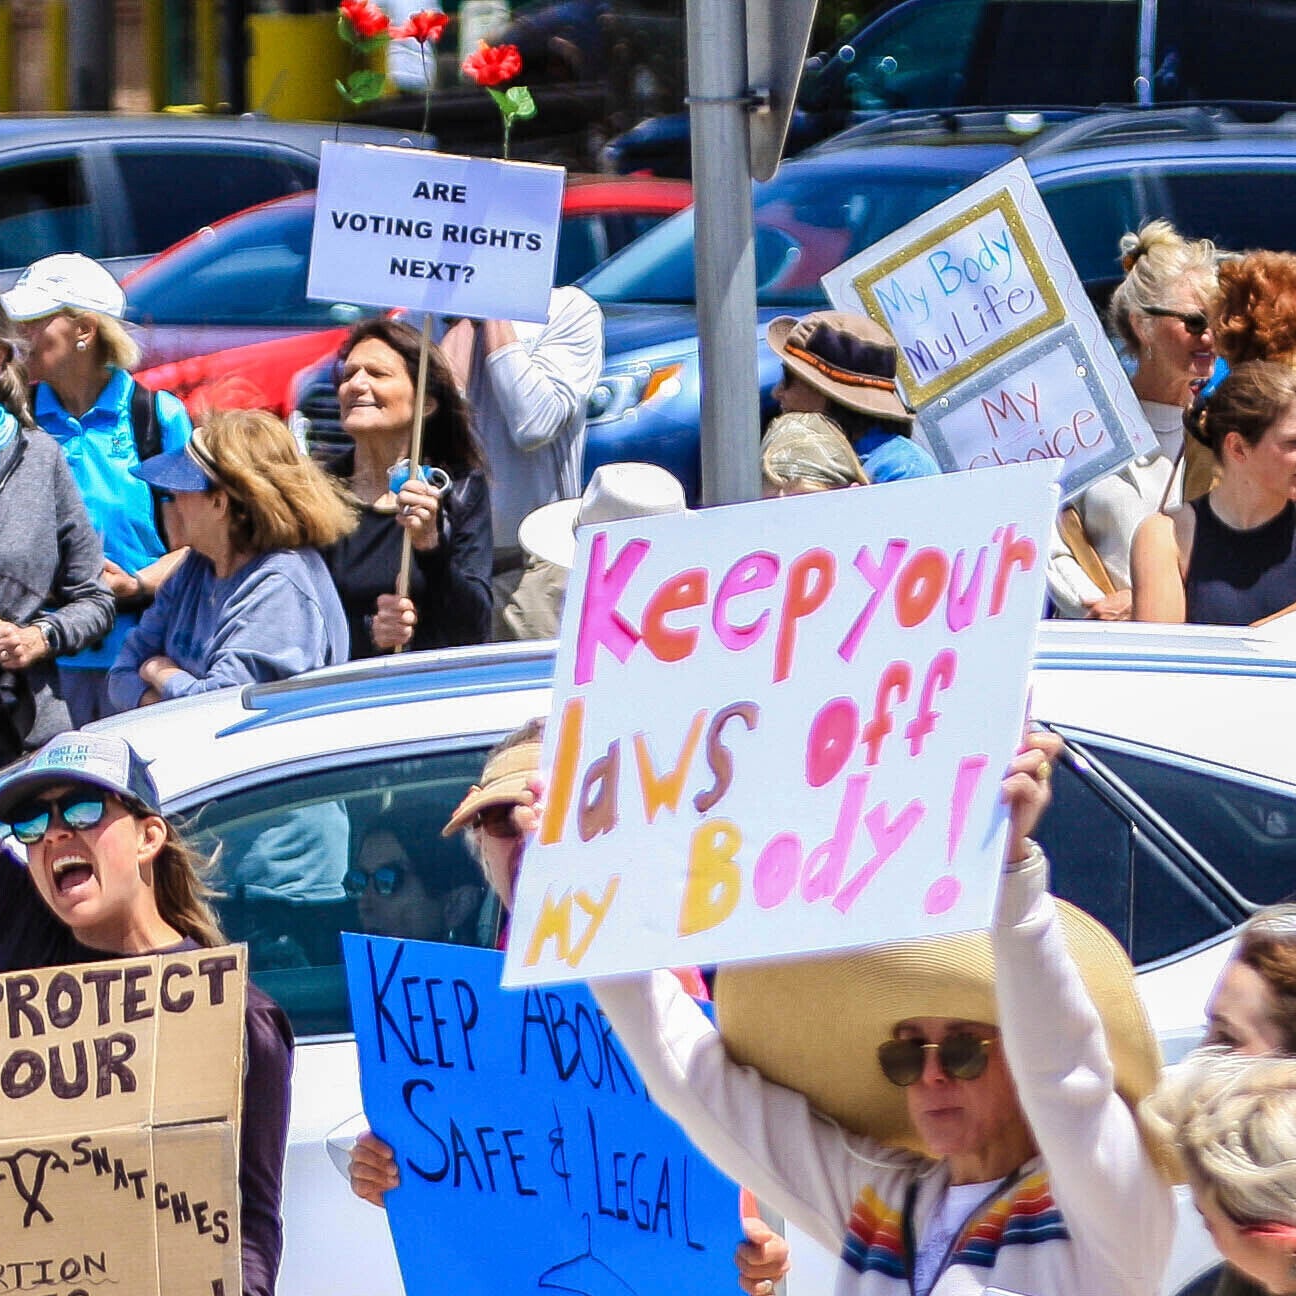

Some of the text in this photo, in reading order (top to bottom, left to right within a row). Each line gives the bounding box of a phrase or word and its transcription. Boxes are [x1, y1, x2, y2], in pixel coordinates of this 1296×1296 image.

[412, 181, 467, 204] ARE
[331, 211, 542, 253] VOTING RIGHTS
[927, 229, 1013, 296] Body
[389, 256, 476, 286] NEXT?
[951, 284, 1035, 348] Life
[574, 522, 1038, 685] Keep your
[540, 648, 958, 846] laws off
[366, 939, 651, 1100] KEEP ABOR
[0, 1032, 137, 1100] OUR
[71, 1136, 231, 1244] SNATCHES
[404, 1078, 537, 1197] SAFE
[587, 1106, 705, 1251] LEGAL
